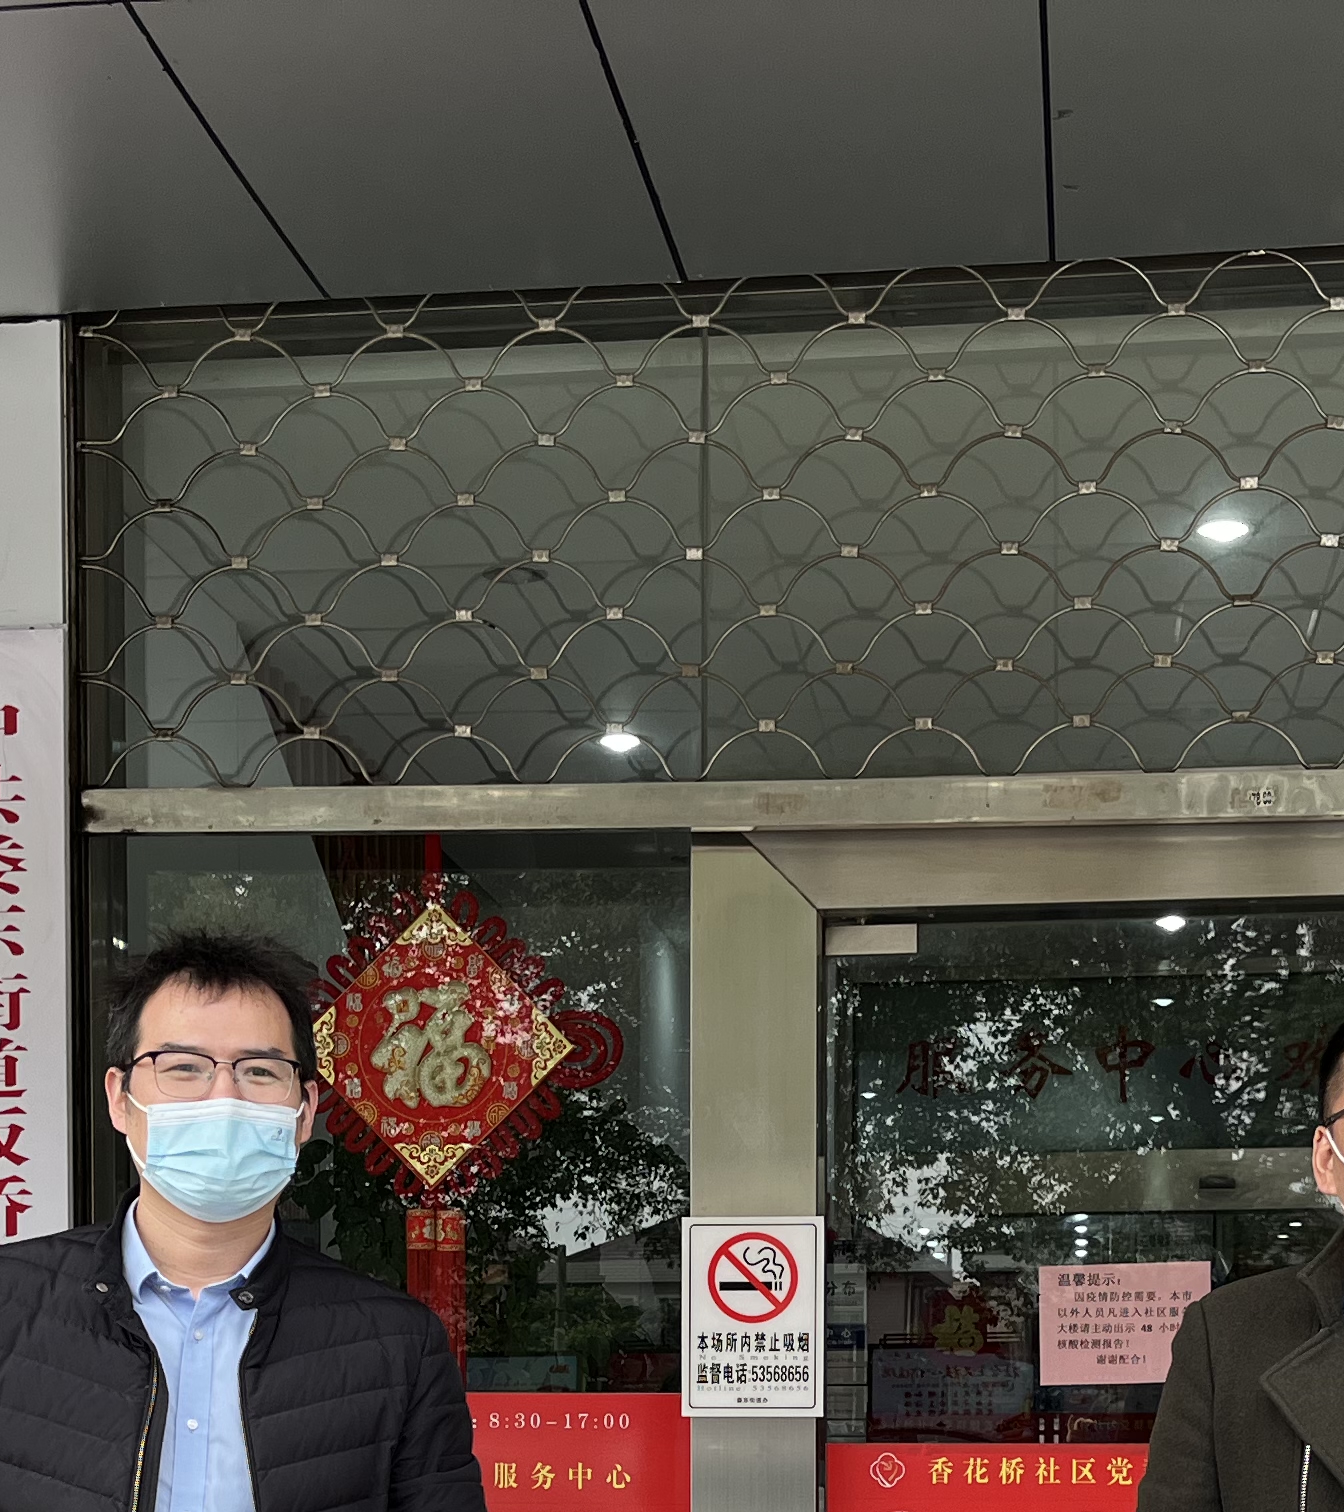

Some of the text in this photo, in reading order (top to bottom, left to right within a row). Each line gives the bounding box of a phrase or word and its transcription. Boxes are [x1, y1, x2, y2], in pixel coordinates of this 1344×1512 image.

[697, 1332, 810, 1353] 本场所内禁止吸烟
[494, 1461, 632, 1490] 服务中心
[927, 1456, 1147, 1486] 香花桥社区党
